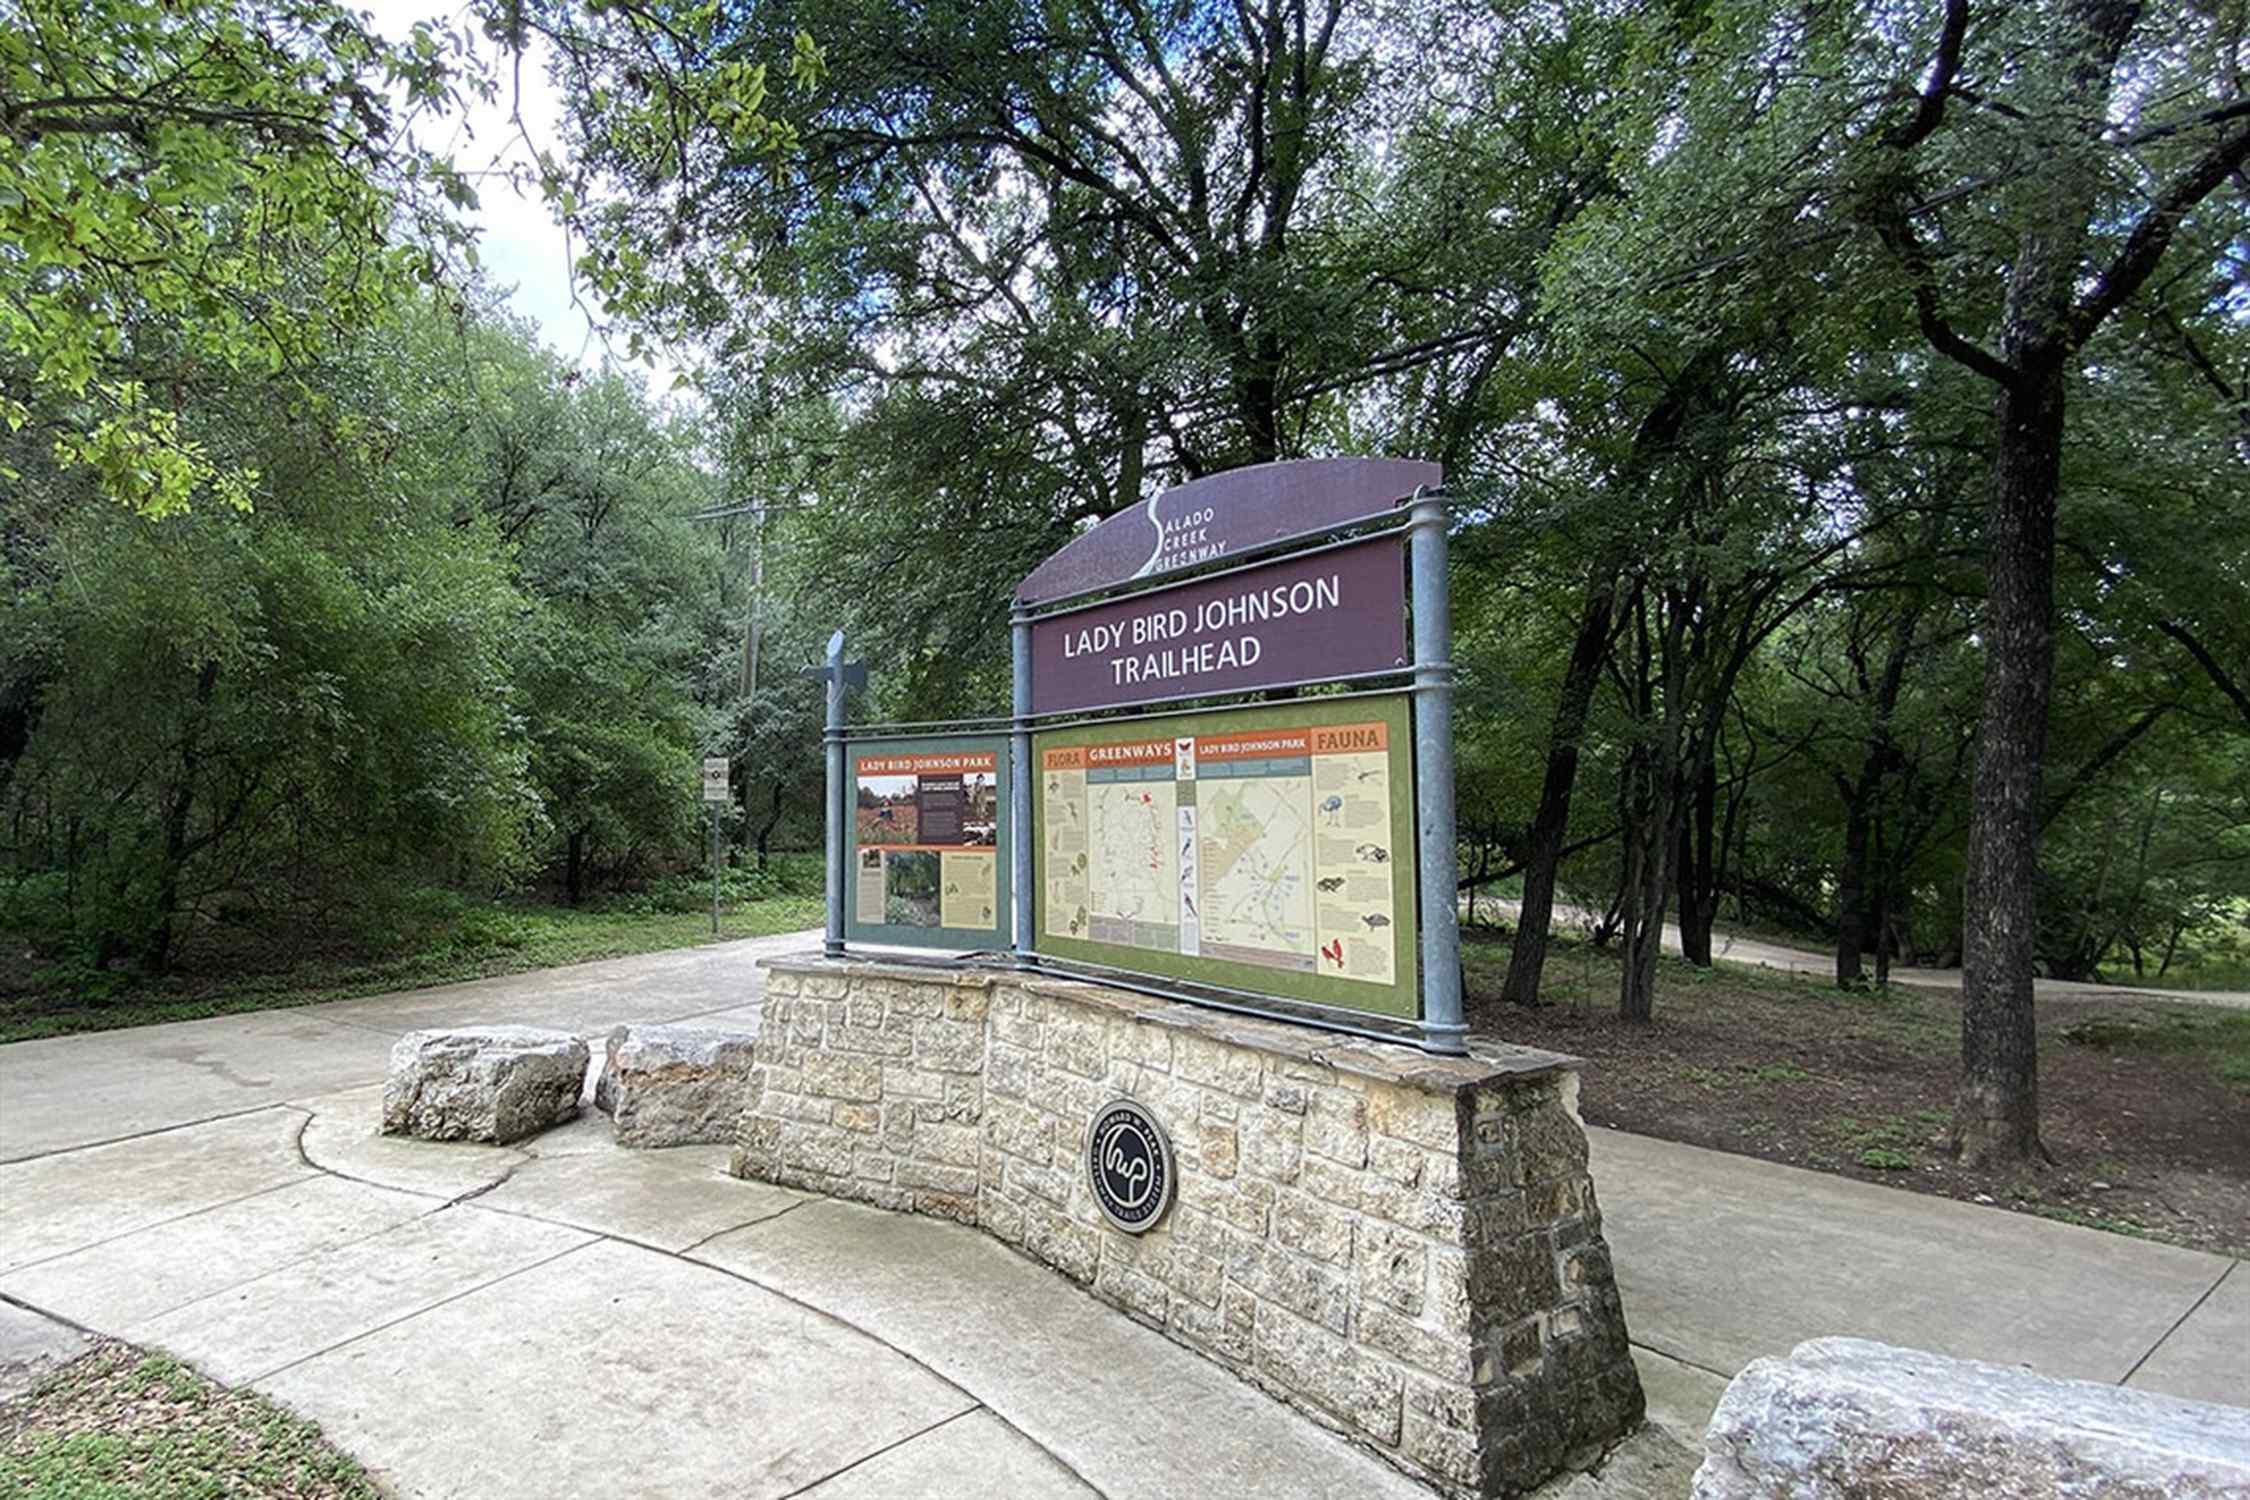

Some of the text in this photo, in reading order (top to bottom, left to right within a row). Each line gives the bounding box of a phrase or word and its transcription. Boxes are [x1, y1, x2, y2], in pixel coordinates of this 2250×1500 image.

[1164, 527, 1207, 552] CREEK
[1155, 540, 1227, 572] GREENWAY
[1064, 575, 1340, 658] LADY BIRD JOHNSON
[1111, 636, 1261, 685] TRAILHEAD
[1200, 738, 1306, 755] LADY BIRD JOHNSON PARK
[1317, 729, 1380, 750] FAUNA
[1047, 752, 1081, 767] FLORA
[1088, 743, 1172, 761] GREENWAYS
[861, 757, 992, 772] LADY BIRD JOHNSON PARK
